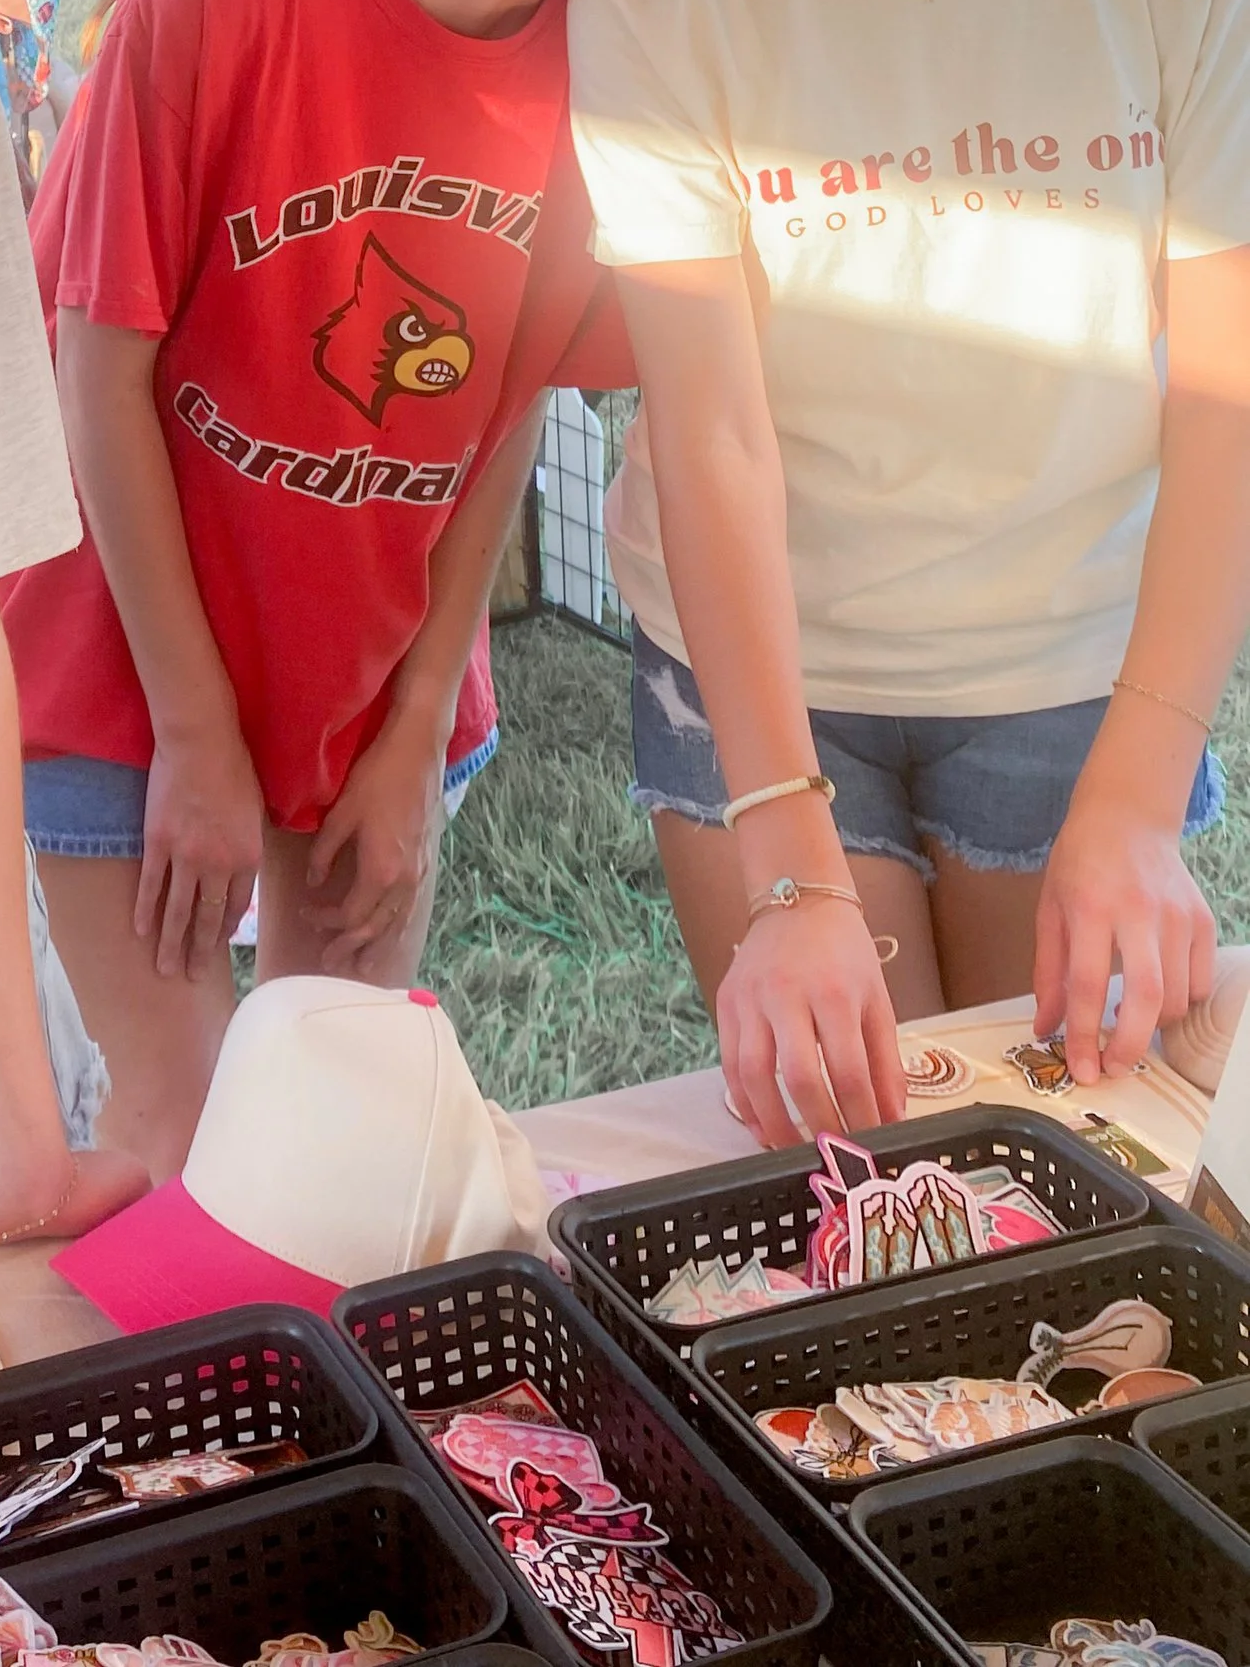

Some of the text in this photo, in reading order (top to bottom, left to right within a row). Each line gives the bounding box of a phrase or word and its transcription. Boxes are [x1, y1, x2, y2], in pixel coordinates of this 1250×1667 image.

[740, 167, 797, 204] u
[820, 151, 932, 197] are
[952, 122, 1060, 176] the
[224, 156, 544, 271] Louisvi
[785, 188, 1100, 238] GOD LOVES
[513, 1557, 745, 1644] YEEHAW
